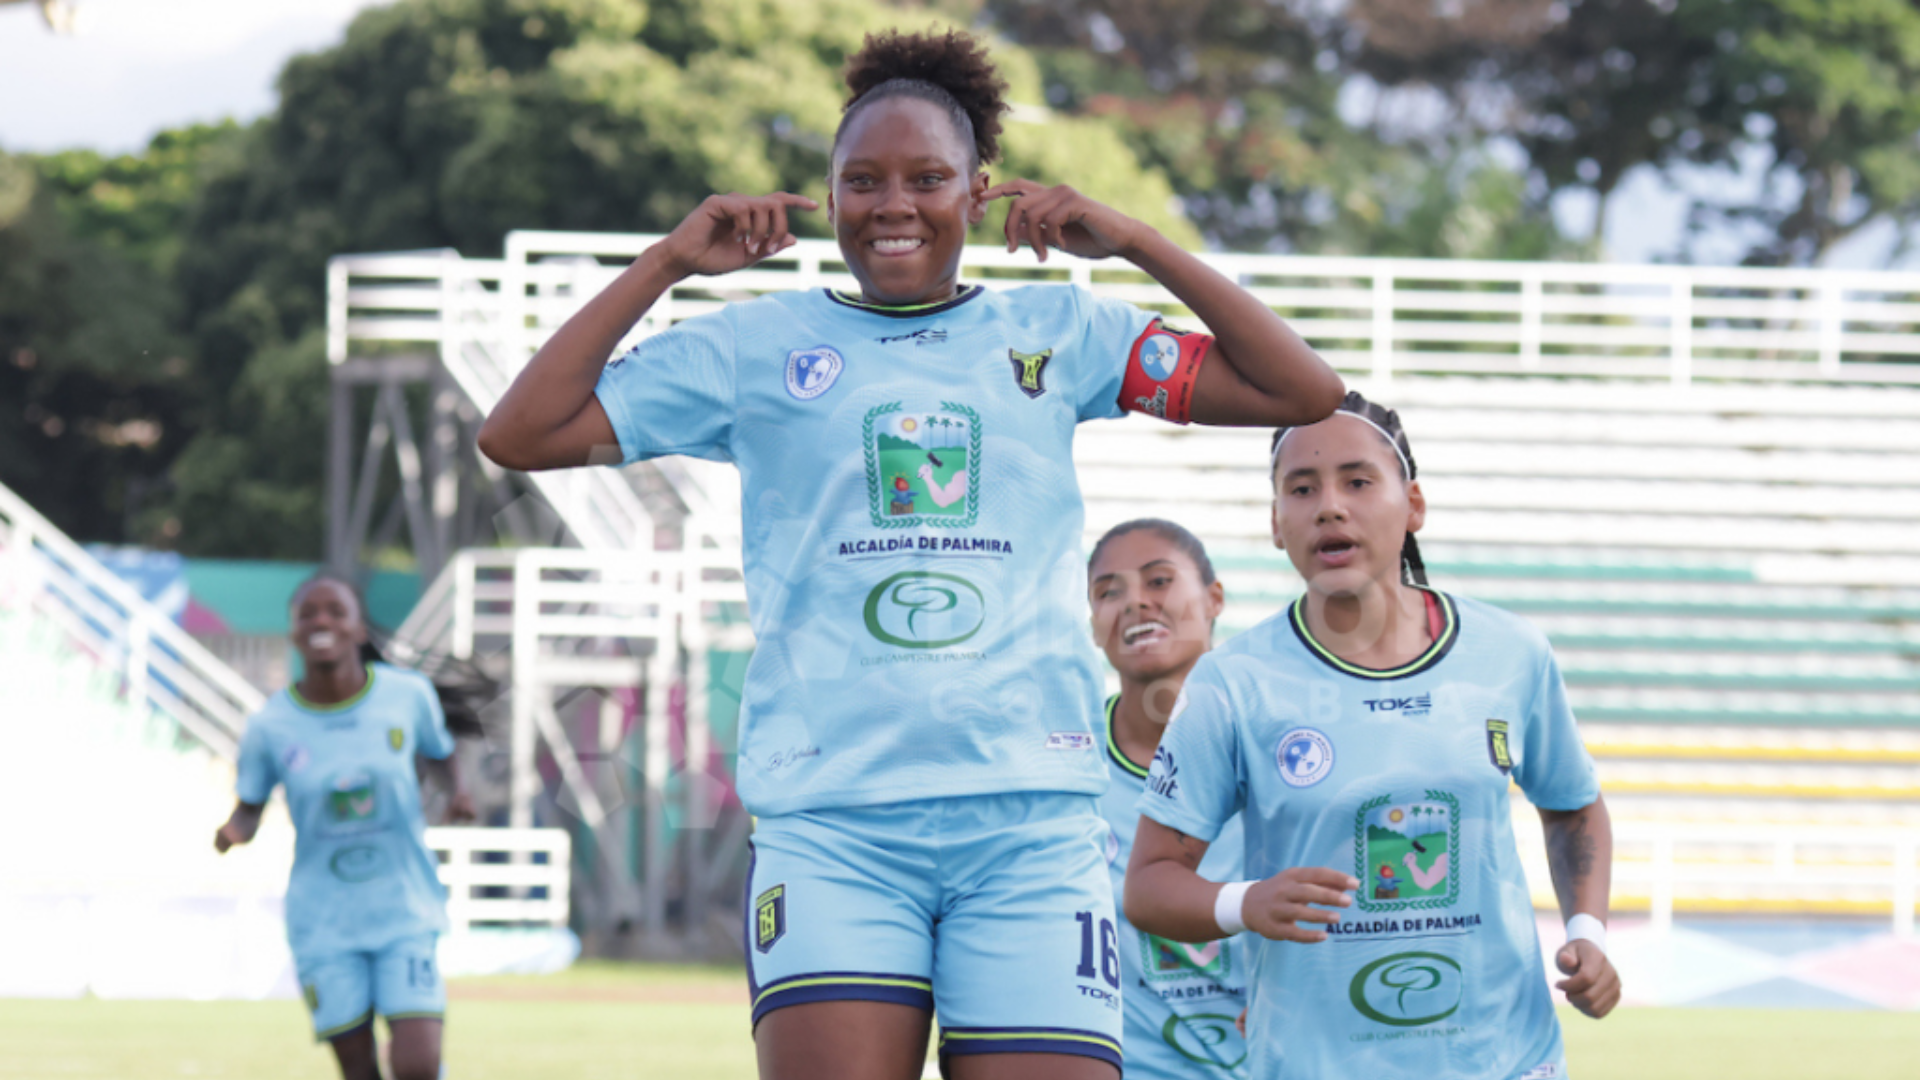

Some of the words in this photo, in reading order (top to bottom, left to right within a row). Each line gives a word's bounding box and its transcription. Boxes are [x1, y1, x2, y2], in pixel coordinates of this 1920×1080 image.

[838, 535, 914, 555] ALCALDÍA
[918, 536, 938, 550] DE
[942, 537, 1013, 554] PALMIRA
[1325, 917, 1399, 935] ALCALDÍA
[1403, 919, 1422, 932] DE
[1426, 913, 1482, 930] PALMIRA
[1075, 911, 1120, 990] 16
